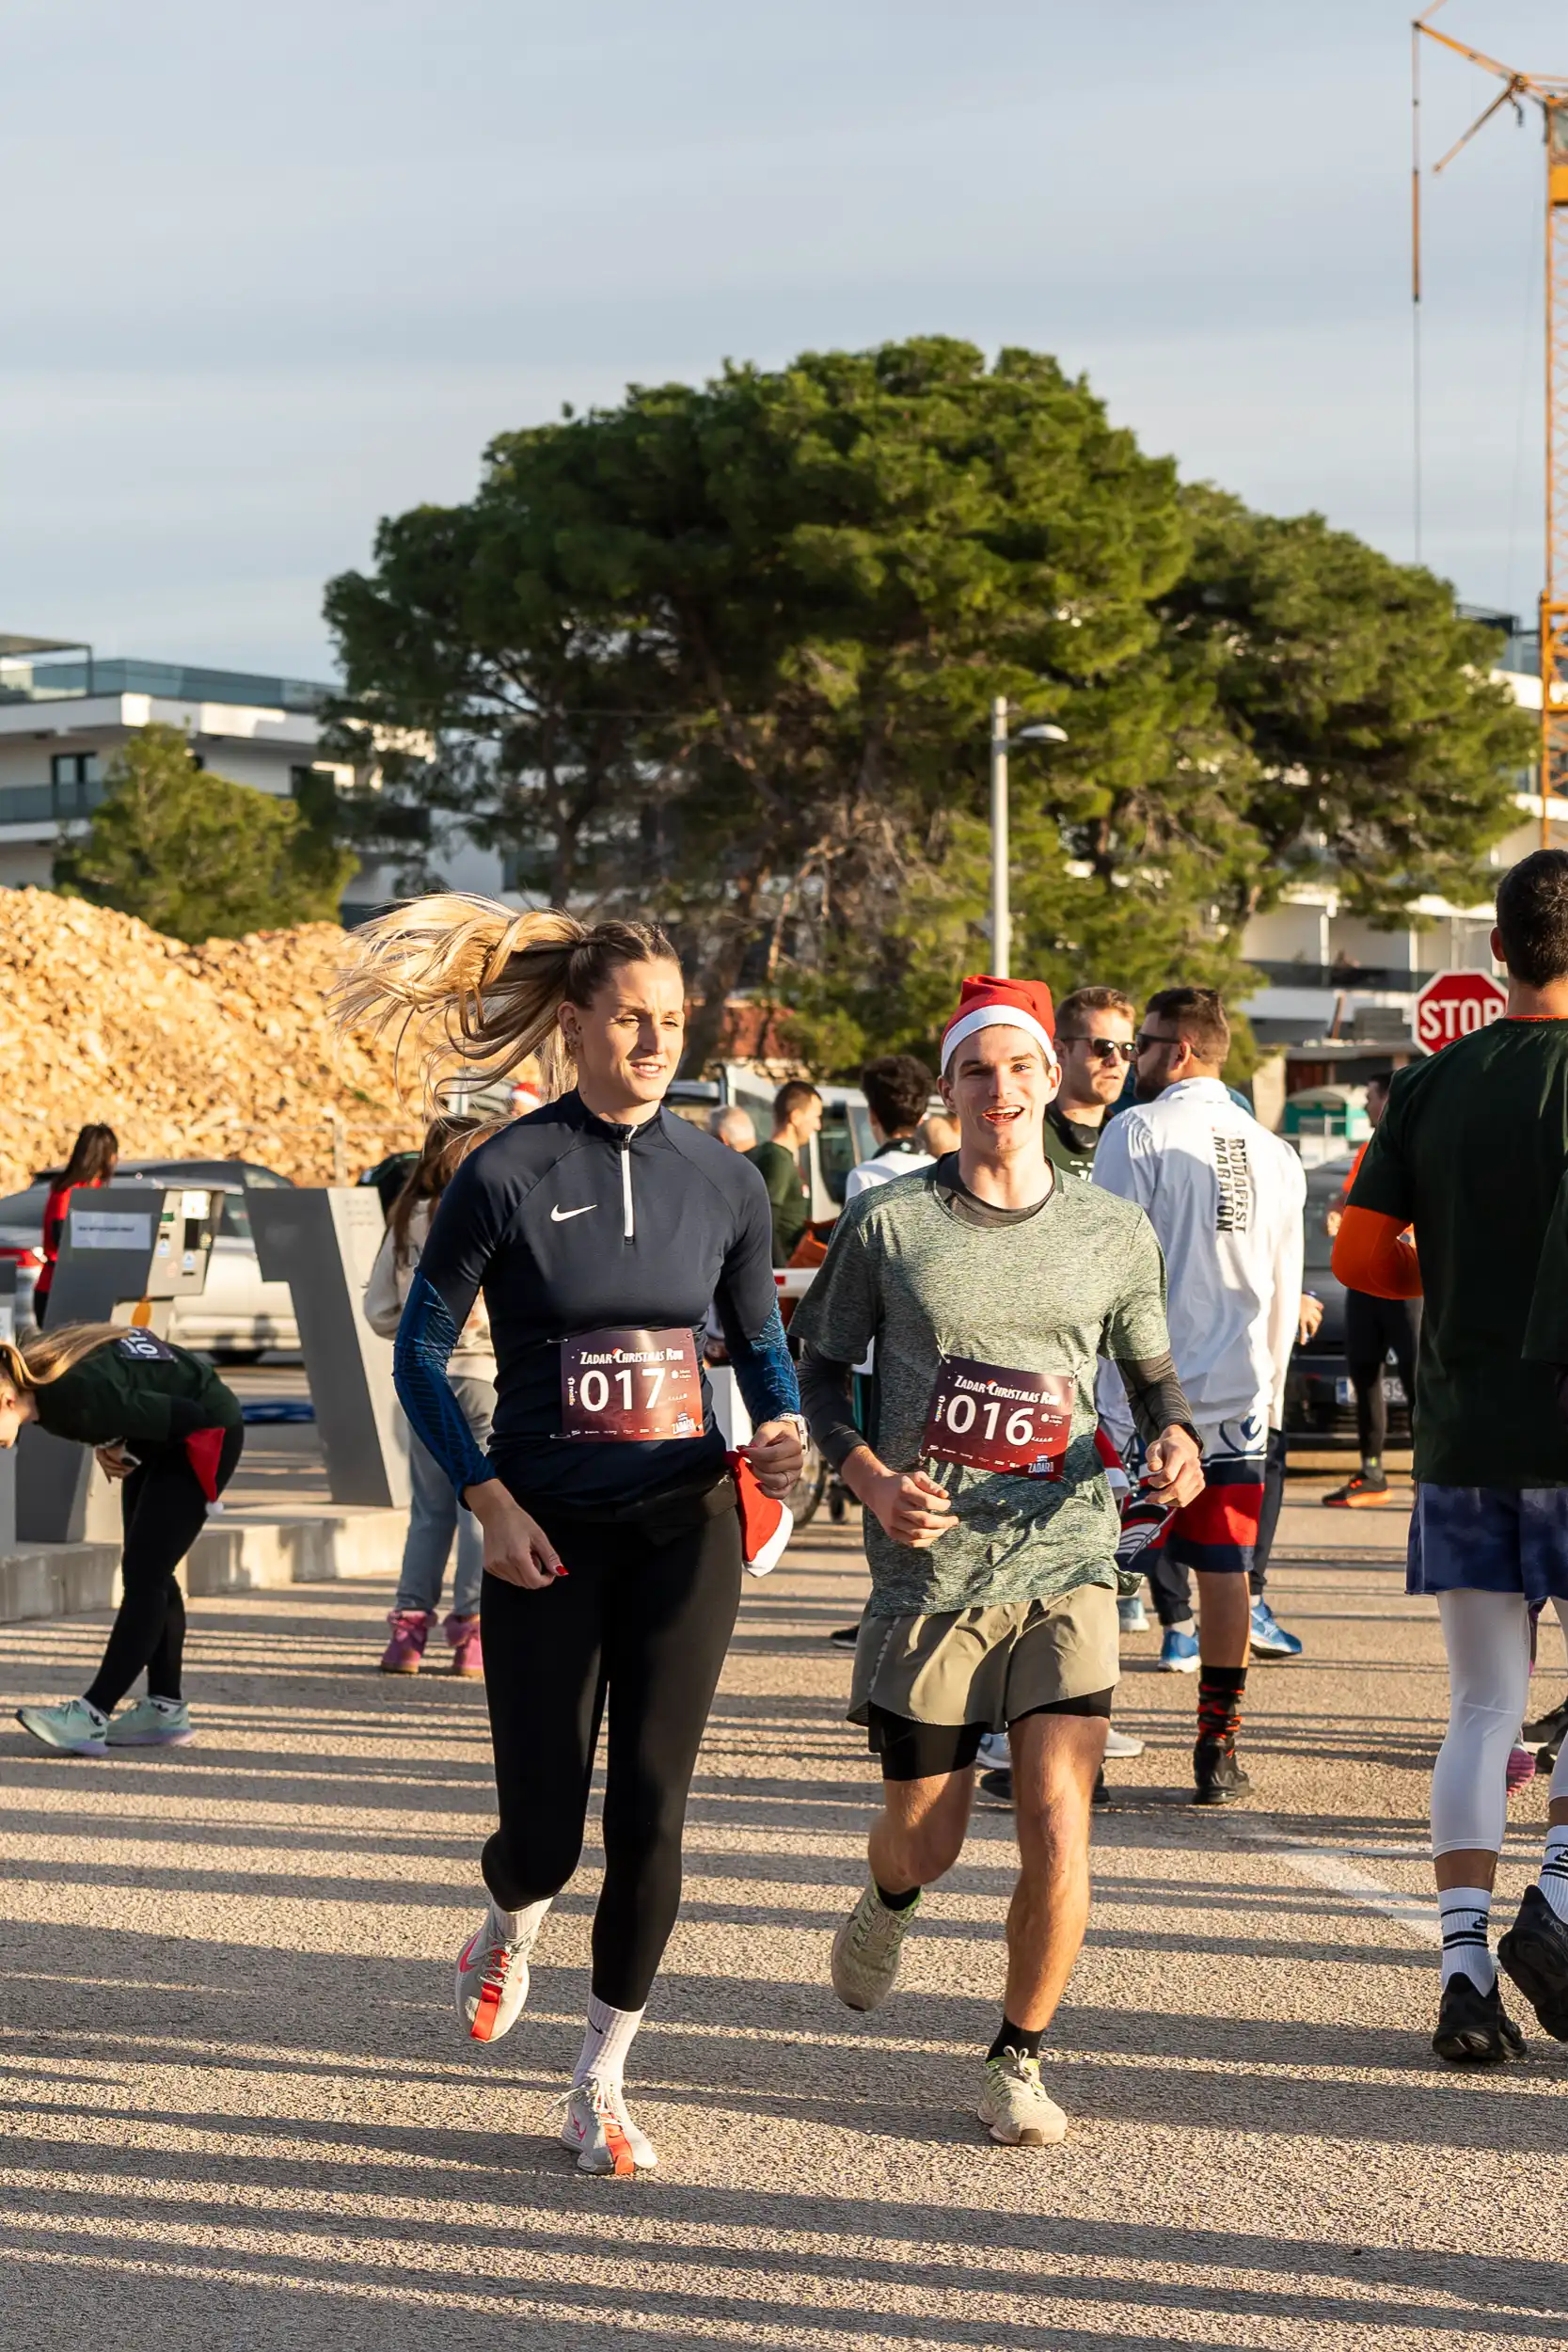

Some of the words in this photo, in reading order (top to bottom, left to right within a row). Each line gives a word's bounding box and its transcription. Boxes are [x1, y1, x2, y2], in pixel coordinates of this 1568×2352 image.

[1419, 998, 1505, 1041] STOP
[1213, 1136, 1234, 1232] MARATON
[1228, 1138, 1249, 1234] BUDAPEST
[579, 1351, 612, 1365] ZADAR
[579, 1368, 666, 1412] 017
[954, 1375, 986, 1393] ZADAR
[946, 1394, 1035, 1446] 016
